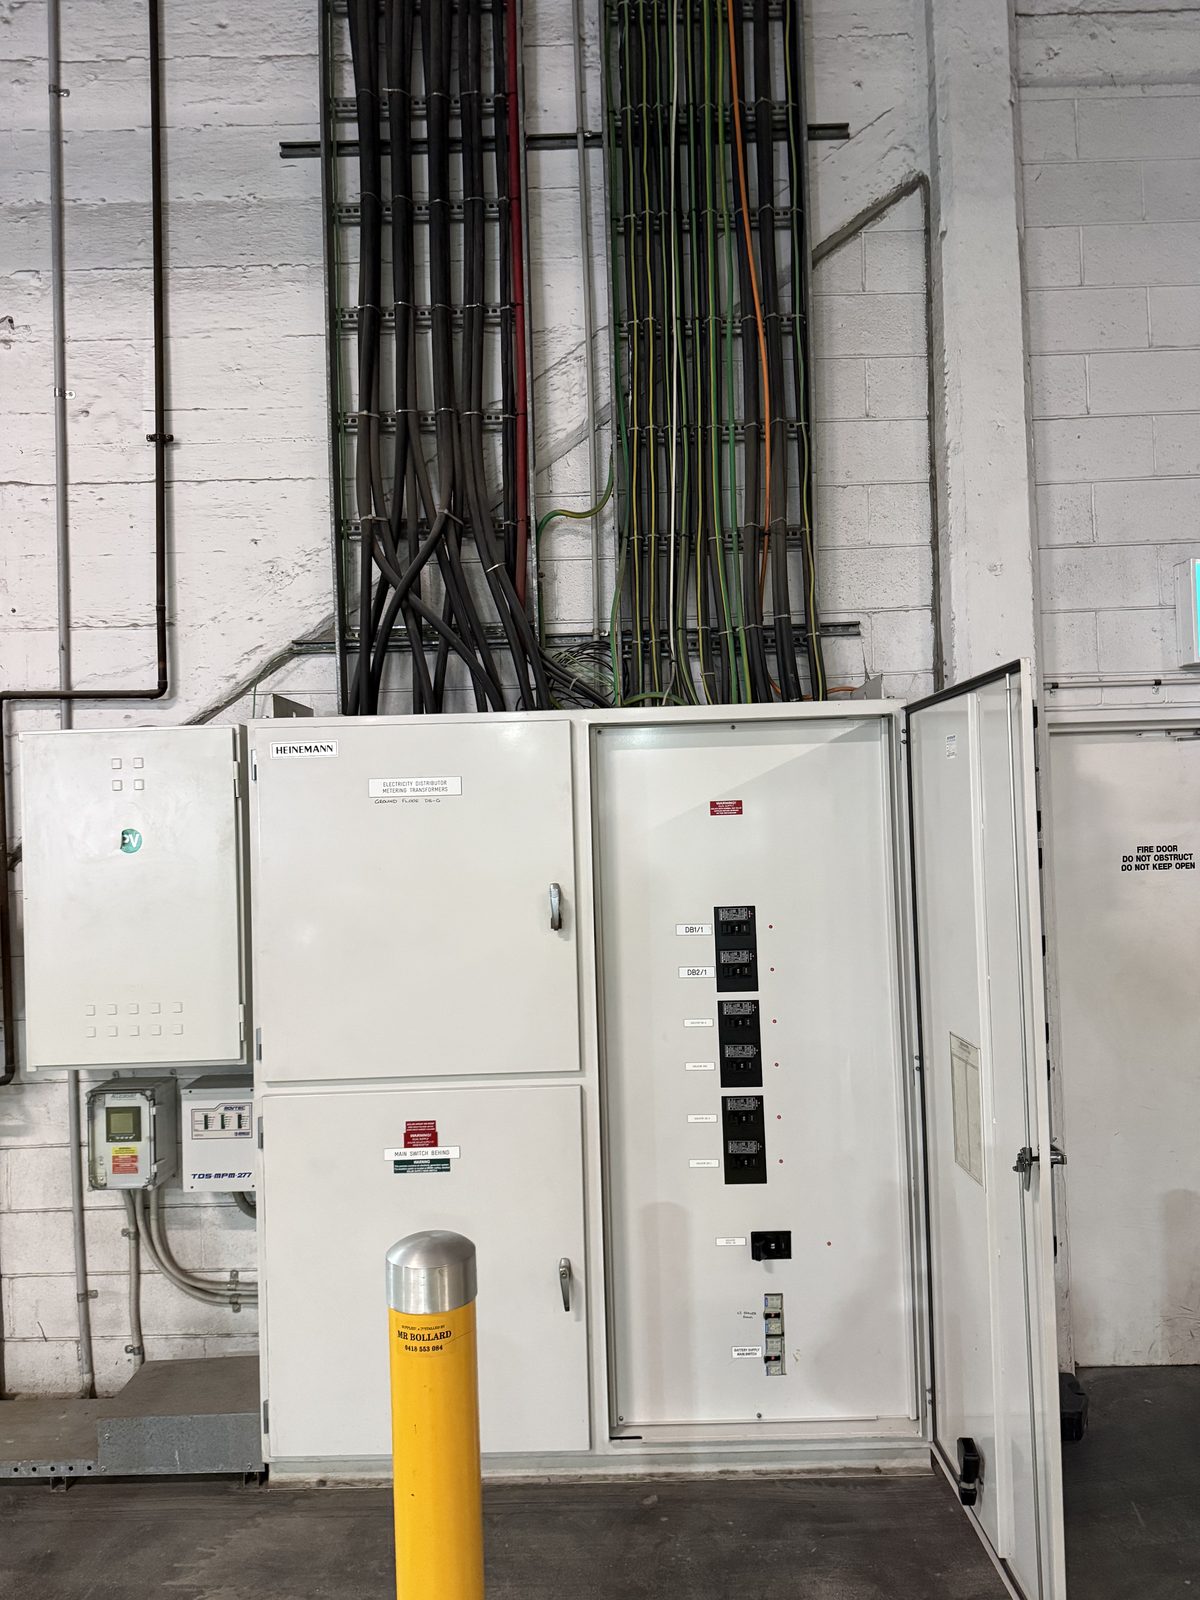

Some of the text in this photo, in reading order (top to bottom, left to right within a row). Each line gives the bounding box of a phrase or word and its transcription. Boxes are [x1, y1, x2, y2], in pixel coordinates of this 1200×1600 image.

[275, 744, 334, 755] HEINEMANN
[382, 779, 448, 788] ELECTRICITY DISTRIBUTOR
[1156, 844, 1178, 853] DOOR
[1122, 853, 1194, 863] DO NOT OBSTRUCT
[1121, 864, 1133, 872] DO
[1134, 863, 1150, 871] NOT
[1152, 862, 1173, 871] KEEP
[397, 1330, 452, 1341] MR BOLLARD
[404, 1344, 418, 1352] 0418
